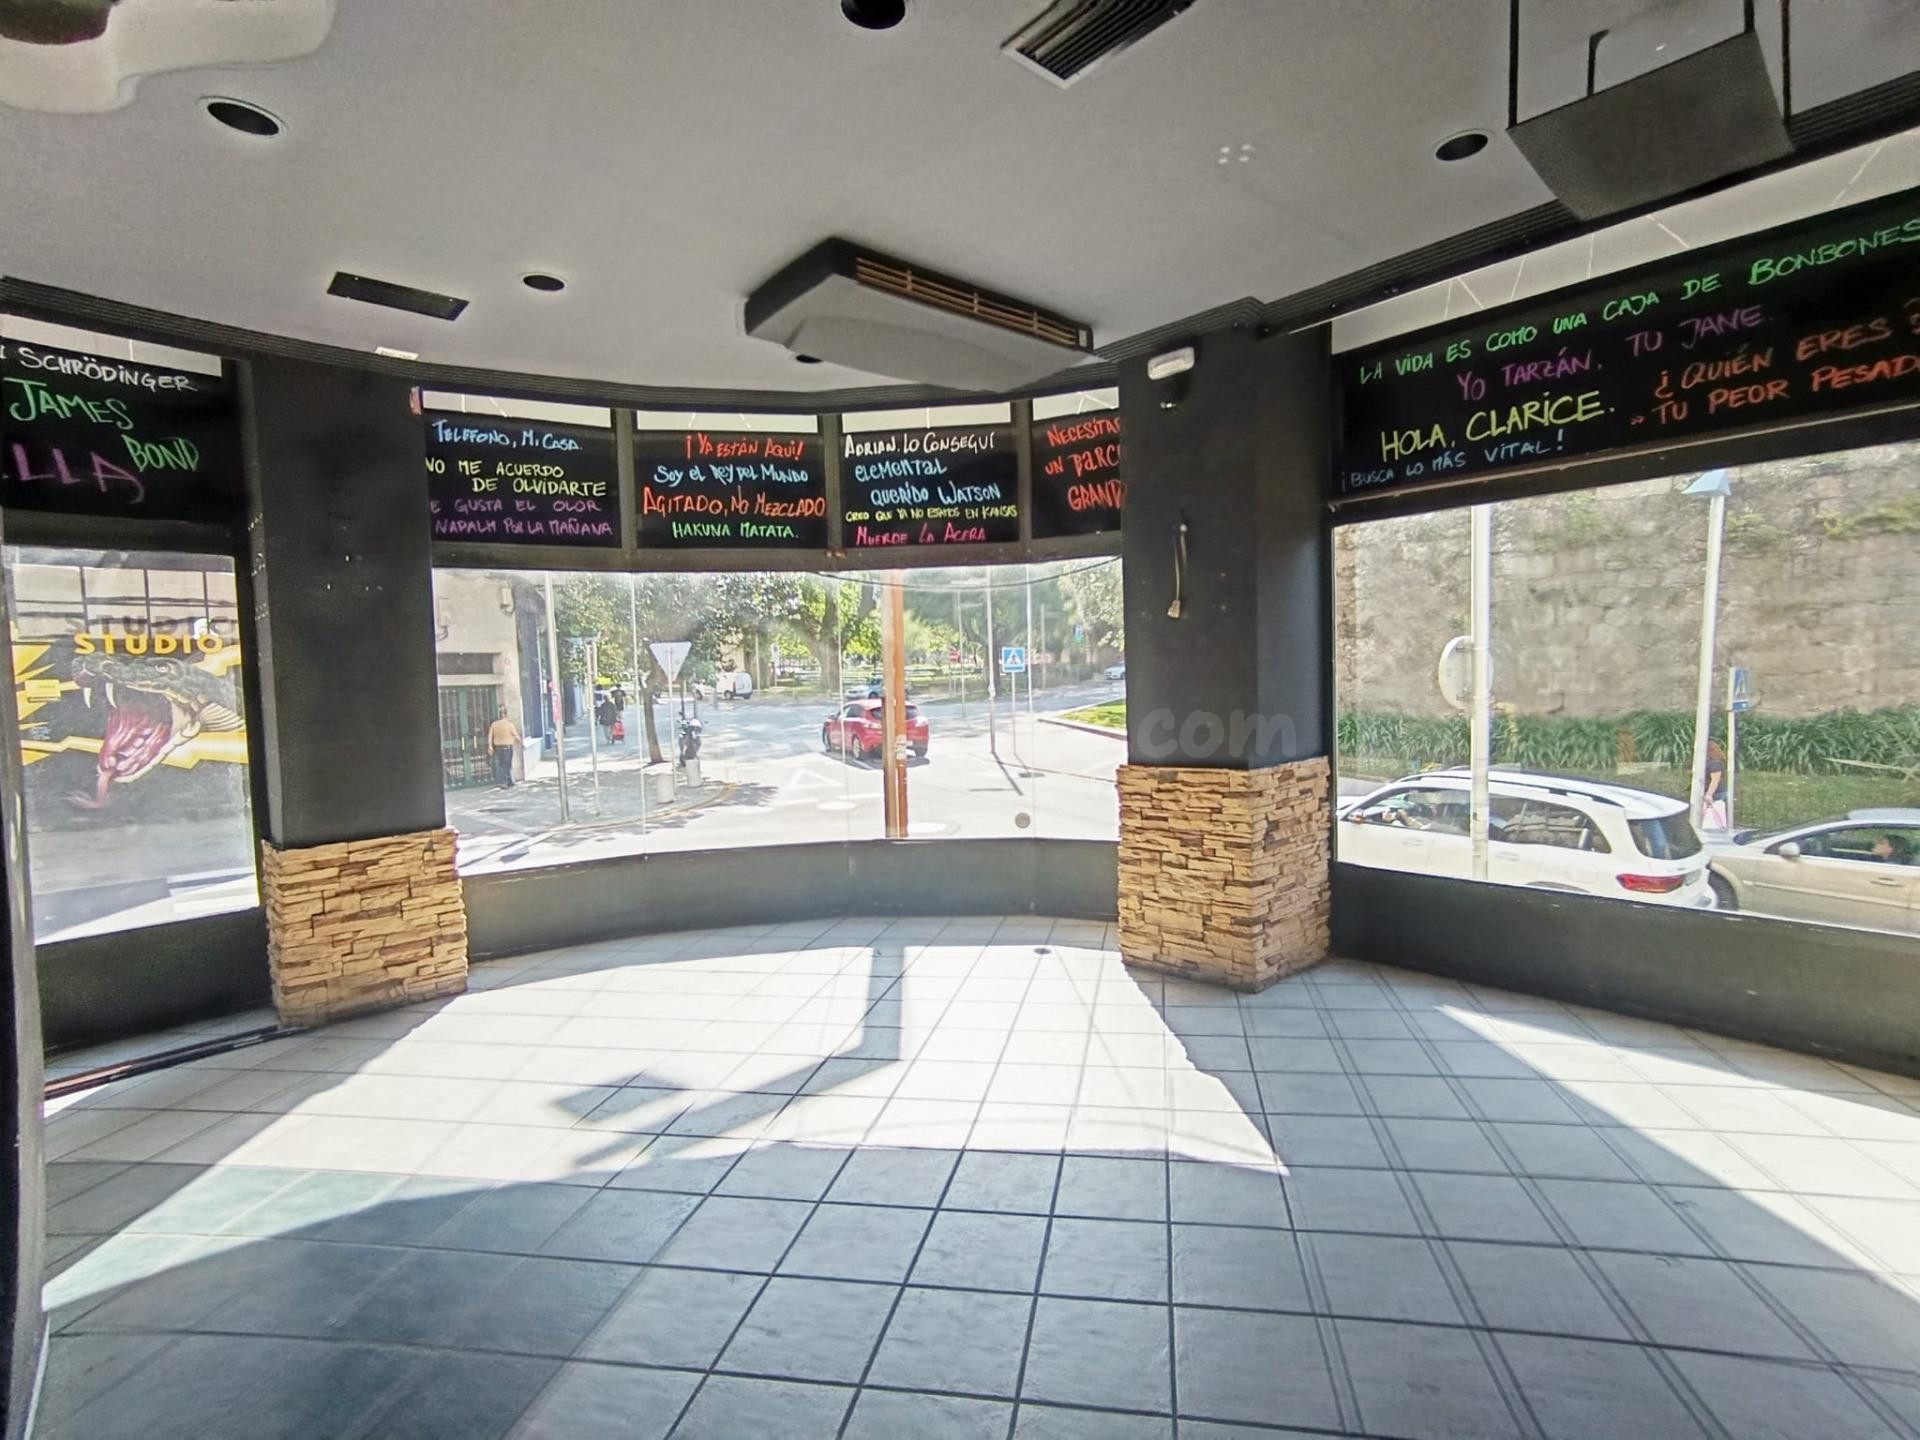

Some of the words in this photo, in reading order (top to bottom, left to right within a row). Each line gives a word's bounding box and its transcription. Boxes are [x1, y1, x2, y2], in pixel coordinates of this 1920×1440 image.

[1359, 360, 1382, 385] LA
[1395, 352, 1433, 377] VIDA
[1445, 340, 1472, 363] ES
[1486, 325, 1537, 352] COMO
[1552, 312, 1588, 335] UNA
[1602, 291, 1660, 321] CAJA
[1680, 272, 1722, 300] DE
[1747, 218, 1920, 286] BONBONES
[1795, 317, 1893, 361] ERES
[17, 346, 198, 392] SCHRÖDINGER
[1457, 370, 1486, 401] YO
[1625, 330, 1663, 357] TU
[1651, 400, 1689, 425] TU
[1708, 379, 1791, 414] PEOR
[1811, 354, 1920, 392] PESAD
[3, 376, 134, 431] JAMES
[121, 432, 200, 473] BOND
[903, 433, 921, 454] LO
[458, 460, 482, 476] ME
[495, 461, 565, 479] ACUERDO
[1044, 455, 1065, 475] UN
[1405, 461, 1425, 477] LO
[471, 477, 499, 492] DE
[512, 478, 607, 497] OLVIDARTE
[936, 479, 1002, 505] WATSON
[454, 499, 503, 515] GUSTA
[515, 499, 537, 512] EL
[552, 499, 603, 513] OLOR
[964, 507, 979, 520] EN
[435, 518, 497, 534] NAPALM
[527, 520, 545, 535] LA
[548, 517, 614, 536] MAÑANA
[671, 521, 731, 539] HAKUNA
[943, 521, 987, 543] ACERA
[74, 632, 224, 655] STUDIO
